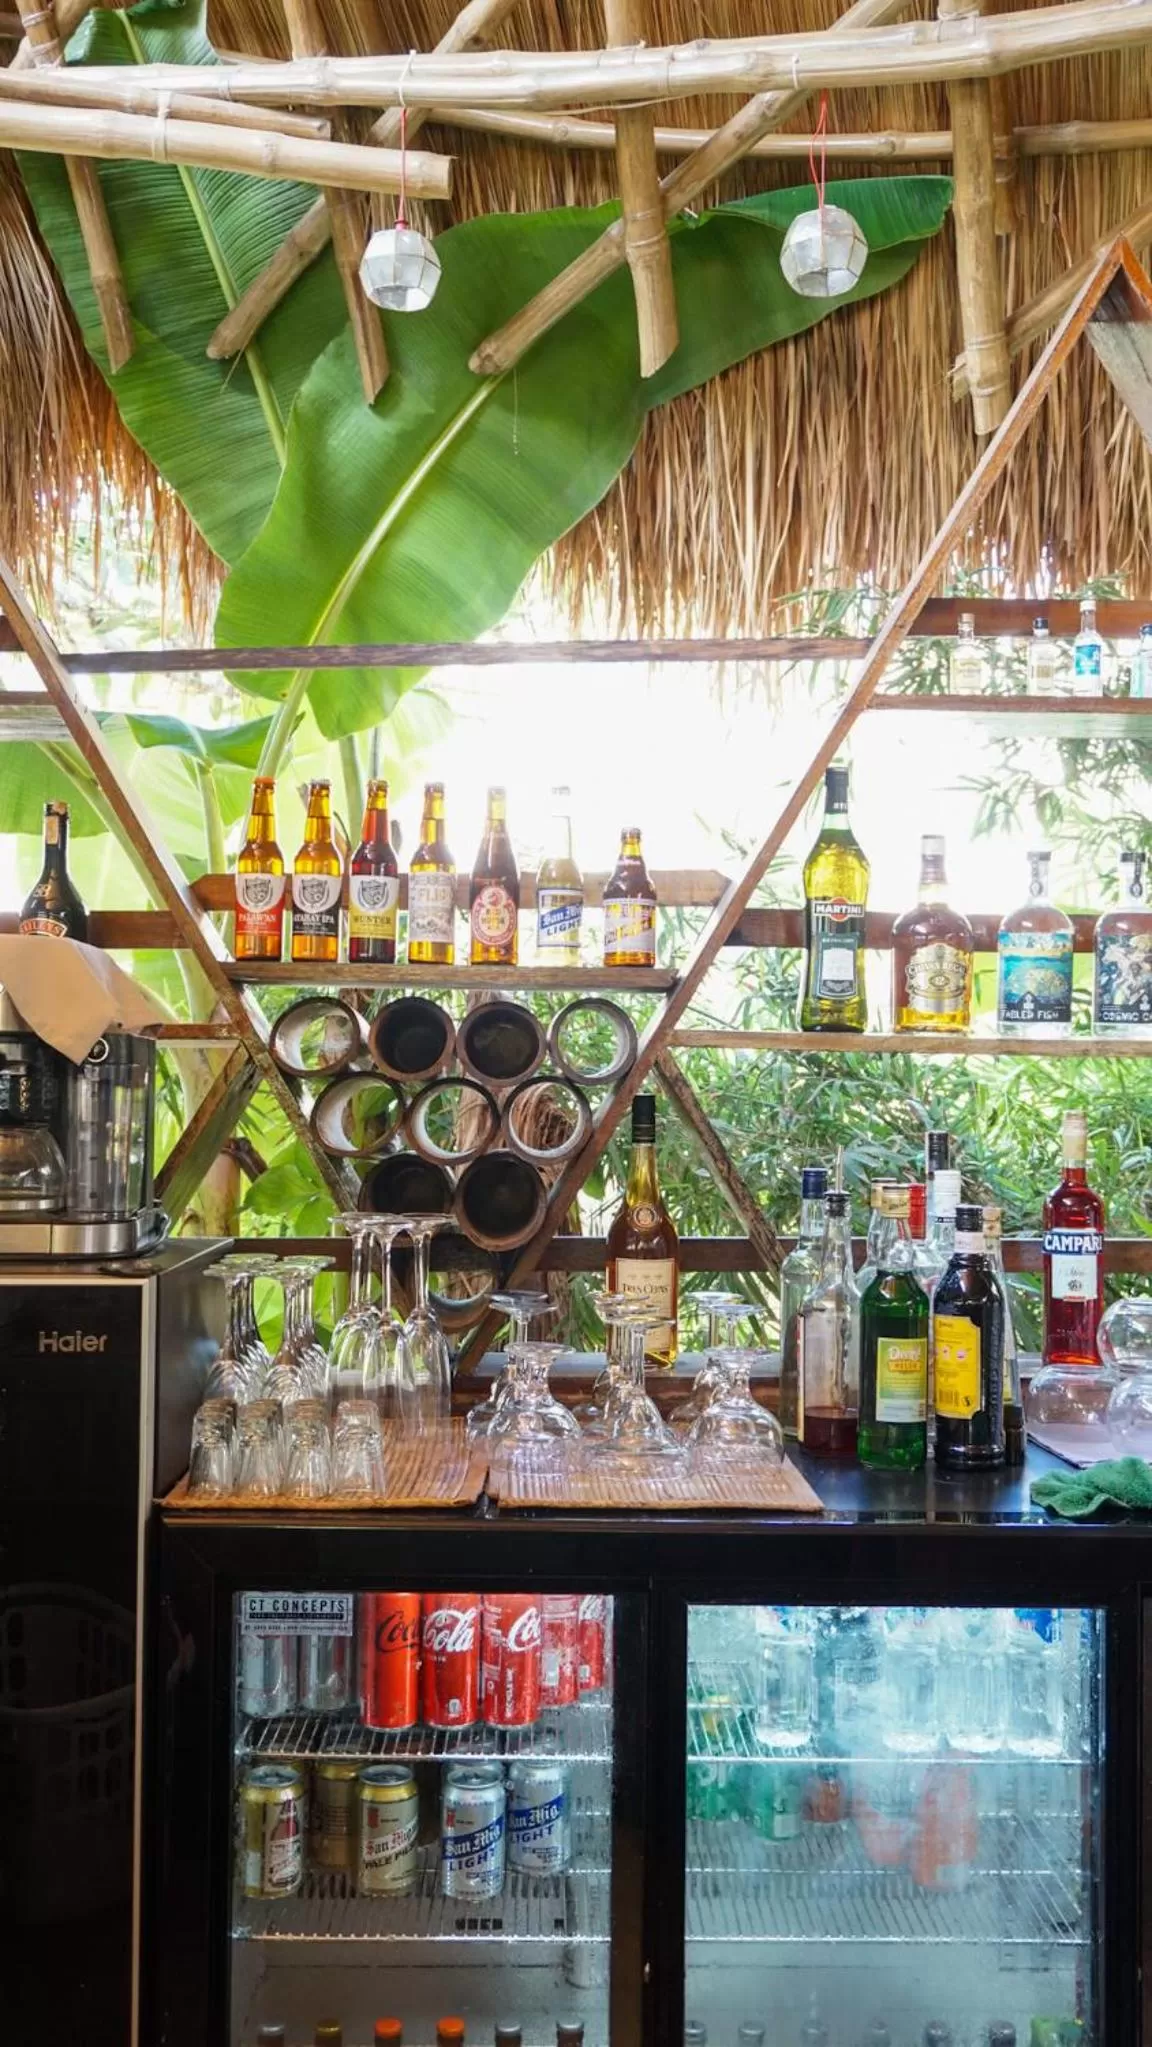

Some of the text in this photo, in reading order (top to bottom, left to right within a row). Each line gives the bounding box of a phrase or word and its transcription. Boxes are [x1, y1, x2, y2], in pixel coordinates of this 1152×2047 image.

[815, 904, 862, 914] MARTINI
[1044, 1234, 1102, 1254] CAMPARI
[38, 1330, 108, 1352] Haier
[249, 1600, 345, 1613] CT CONCEPTS
